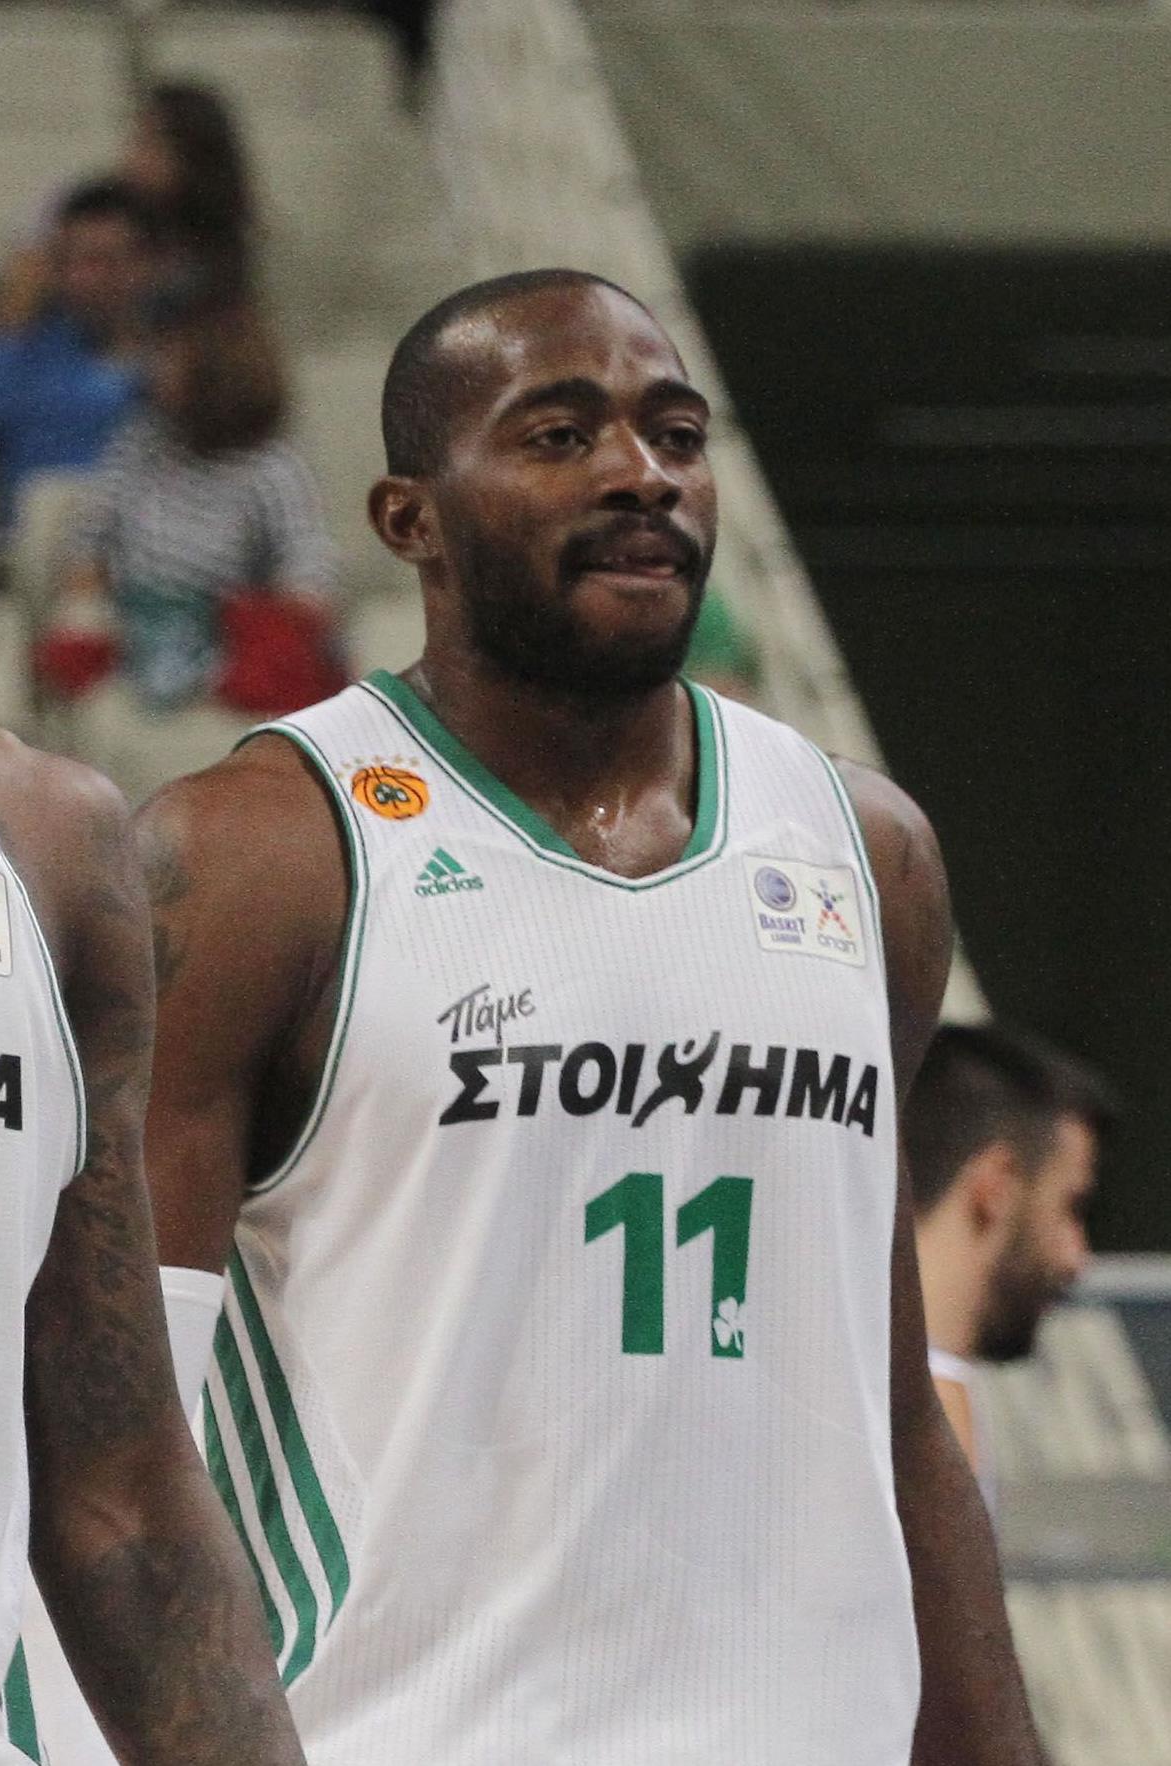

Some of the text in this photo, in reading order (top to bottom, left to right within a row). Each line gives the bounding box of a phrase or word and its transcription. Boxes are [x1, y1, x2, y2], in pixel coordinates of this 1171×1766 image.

[415, 875, 484, 897] adidas
[438, 1030, 880, 1138] ΣΤΟΙΧΗΜΑ
[584, 1172, 754, 1358] 11
